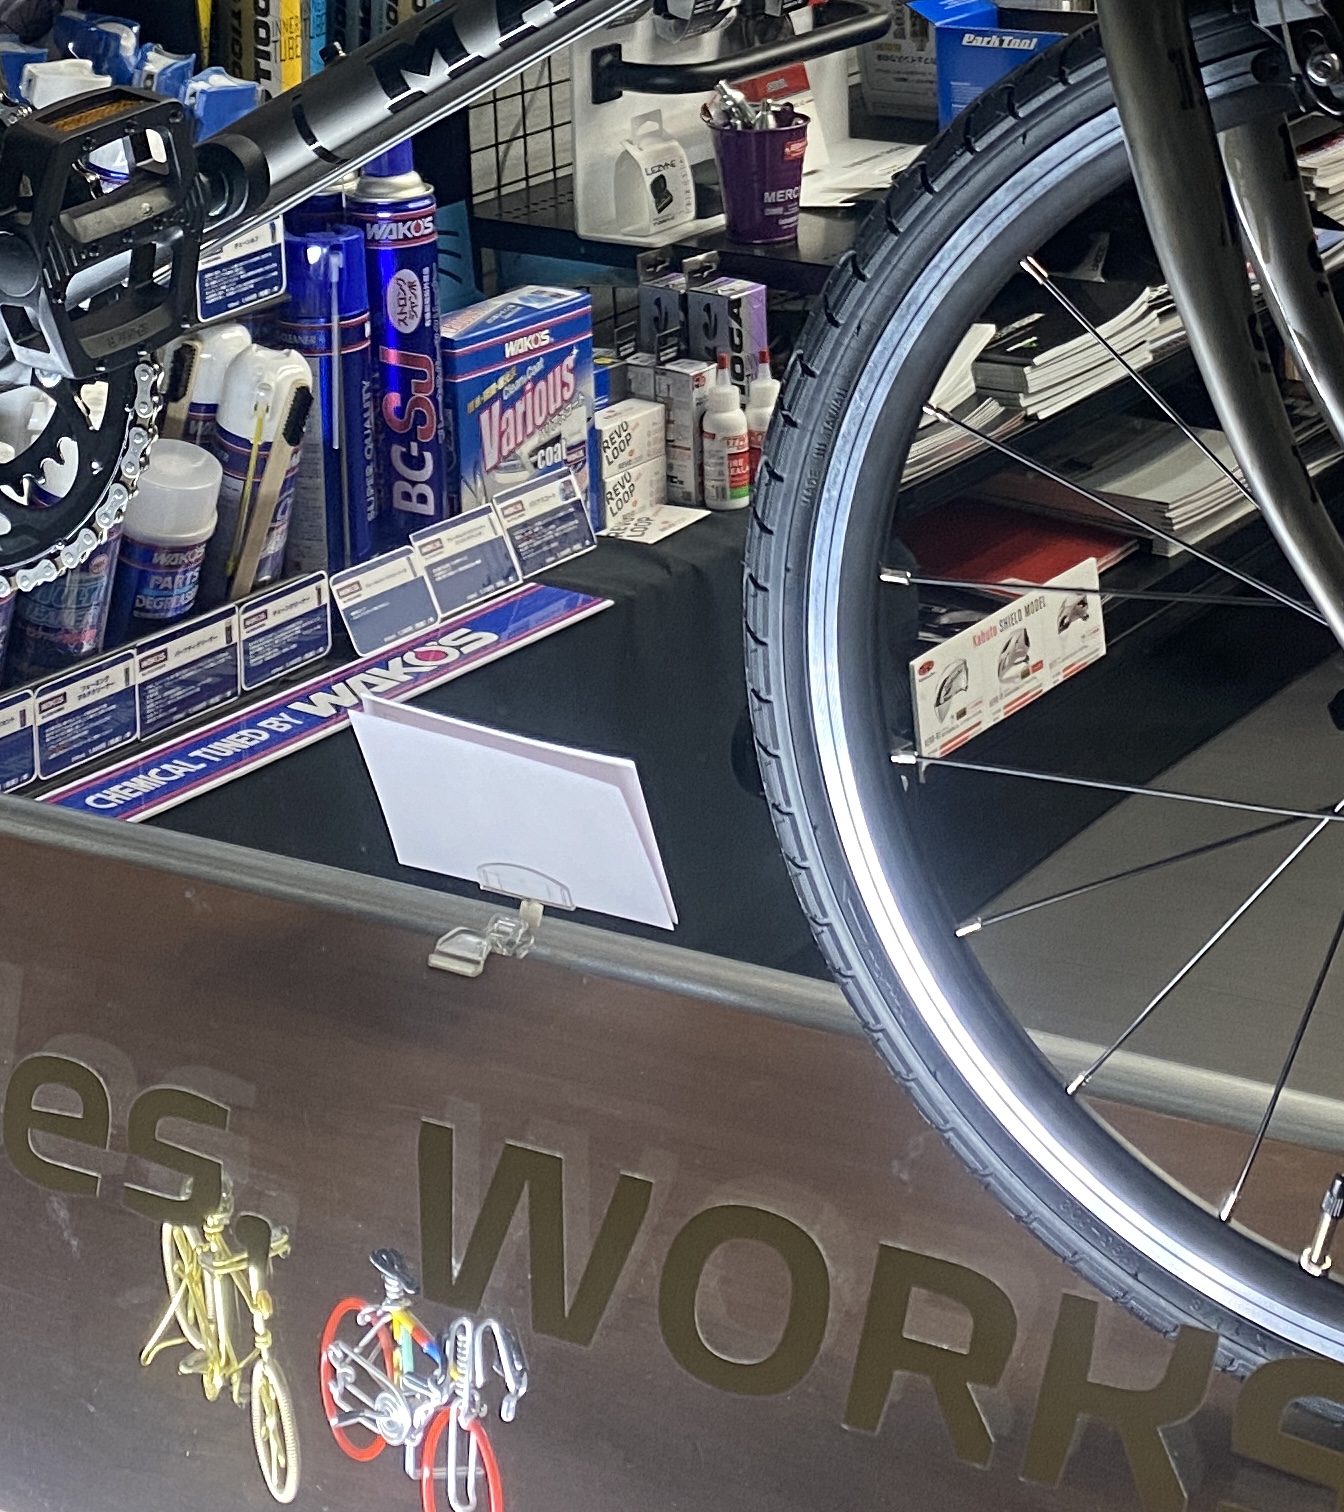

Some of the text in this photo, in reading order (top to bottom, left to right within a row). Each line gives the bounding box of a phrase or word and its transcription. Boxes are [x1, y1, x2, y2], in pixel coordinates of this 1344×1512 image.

[644, 159, 677, 176] LEZYNE
[763, 188, 800, 204] MERC
[361, 379, 376, 463] QUALITY
[479, 352, 577, 474] Various
[536, 436, 569, 470] coat
[601, 420, 629, 453] REVO
[605, 432, 632, 467] LOOP
[605, 471, 632, 506] REVO
[609, 483, 636, 518] LOOP
[149, 568, 201, 589] PARTS
[998, 611, 1023, 634] SHIELD
[1023, 595, 1048, 621] MODEL
[85, 756, 203, 810] CHEMICAL
[192, 725, 272, 766] TUNED
[270, 711, 305, 736] BY
